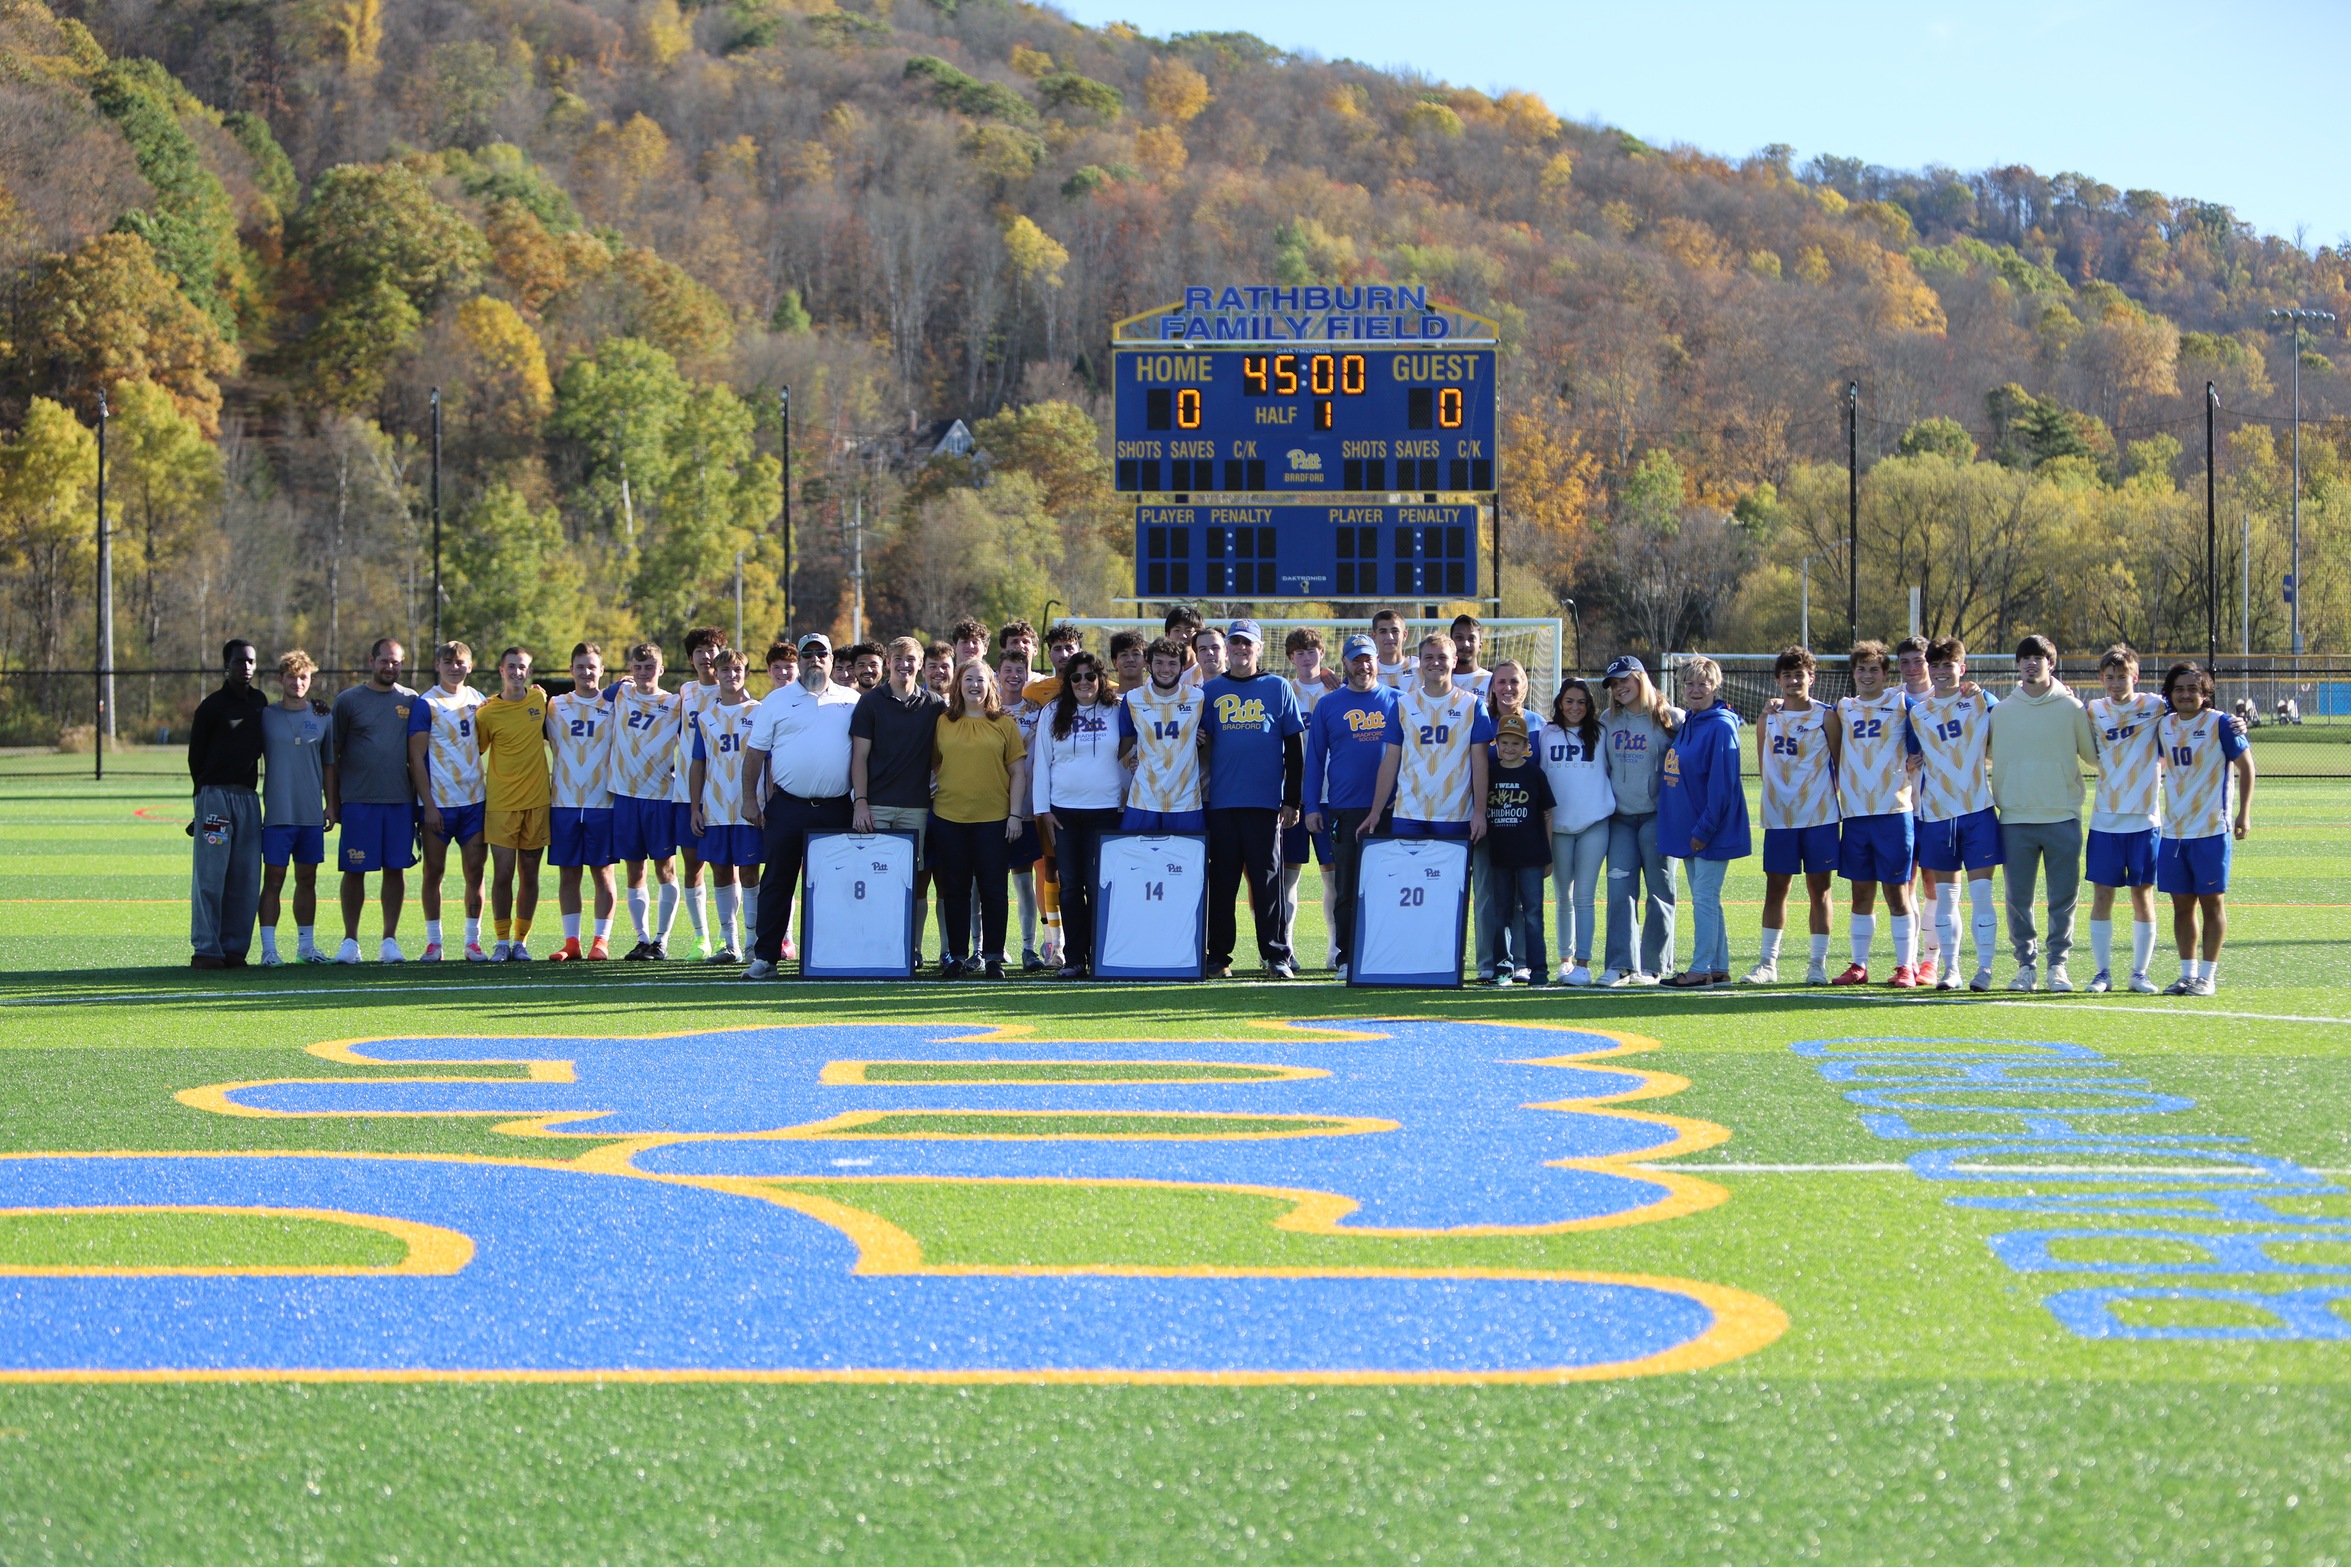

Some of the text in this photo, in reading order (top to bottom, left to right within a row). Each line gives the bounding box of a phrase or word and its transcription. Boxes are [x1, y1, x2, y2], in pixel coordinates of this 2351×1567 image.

[1185, 286, 1426, 311] RATHBURN
[1161, 315, 1450, 340] FAMILY FIELD
[1137, 356, 1213, 381] HOME
[1243, 355, 1365, 394] 45:00
[1393, 355, 1480, 381] GUEST
[1177, 389, 1201, 428] 0
[1256, 406, 1297, 424] HALF
[1324, 401, 1332, 428] 1
[1438, 388, 1462, 427] 0
[1117, 440, 1257, 459] SHOTS SAVES C/K
[1342, 440, 1481, 459] SHOTS SAVES C/K
[1287, 449, 1322, 470] Pitt
[1284, 473, 1324, 482] BRADFORD
[1142, 509, 1272, 523] PLAYER PENALTY
[1329, 509, 1460, 523] PLAYER PENALTY
[1177, 704, 1192, 712] Pitt
[1214, 693, 1266, 724] Pitt
[1448, 709, 1461, 717] Pitt
[460, 719, 470, 737] 9
[571, 719, 594, 737] 21
[628, 710, 655, 731] 27
[1072, 715, 1107, 733] Pitt
[1222, 722, 1262, 731] BRADFORD
[1343, 709, 1386, 731] Pitt
[1854, 719, 1881, 738] 22
[1154, 721, 1179, 740] 14
[1420, 725, 1448, 744] 20
[1612, 729, 1647, 751] Pitt
[1937, 719, 1963, 742] 19
[720, 733, 740, 752] 31
[1773, 735, 1798, 755] 25
[2172, 747, 2192, 766] 10
[1487, 808, 1528, 818] CHILDHOOD
[871, 861, 888, 871] Pitt
[1166, 863, 1183, 873] Pitt
[1424, 868, 1441, 877] Pitt
[854, 880, 866, 900] 8
[1145, 881, 1163, 901] 14
[1400, 887, 1424, 907] 20
